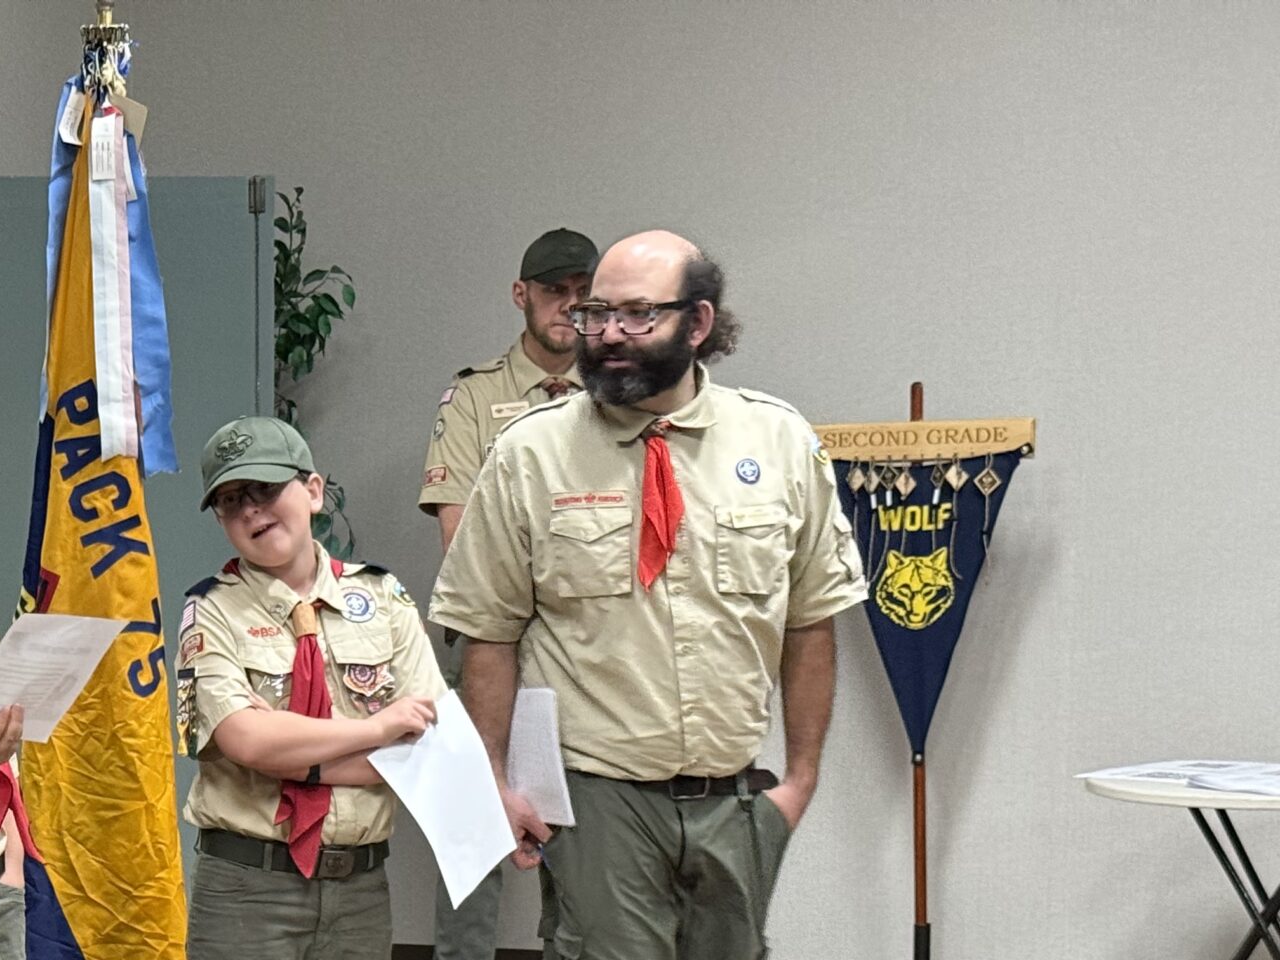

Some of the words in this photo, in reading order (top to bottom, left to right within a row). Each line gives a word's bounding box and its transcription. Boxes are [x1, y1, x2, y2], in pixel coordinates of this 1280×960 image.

[822, 430, 919, 449] SECOND
[926, 426, 1009, 445] GRADE
[878, 503, 953, 532] WOLF
[53, 378, 150, 580] PACK
[120, 596, 166, 698] 75
[260, 626, 282, 638] BSA
